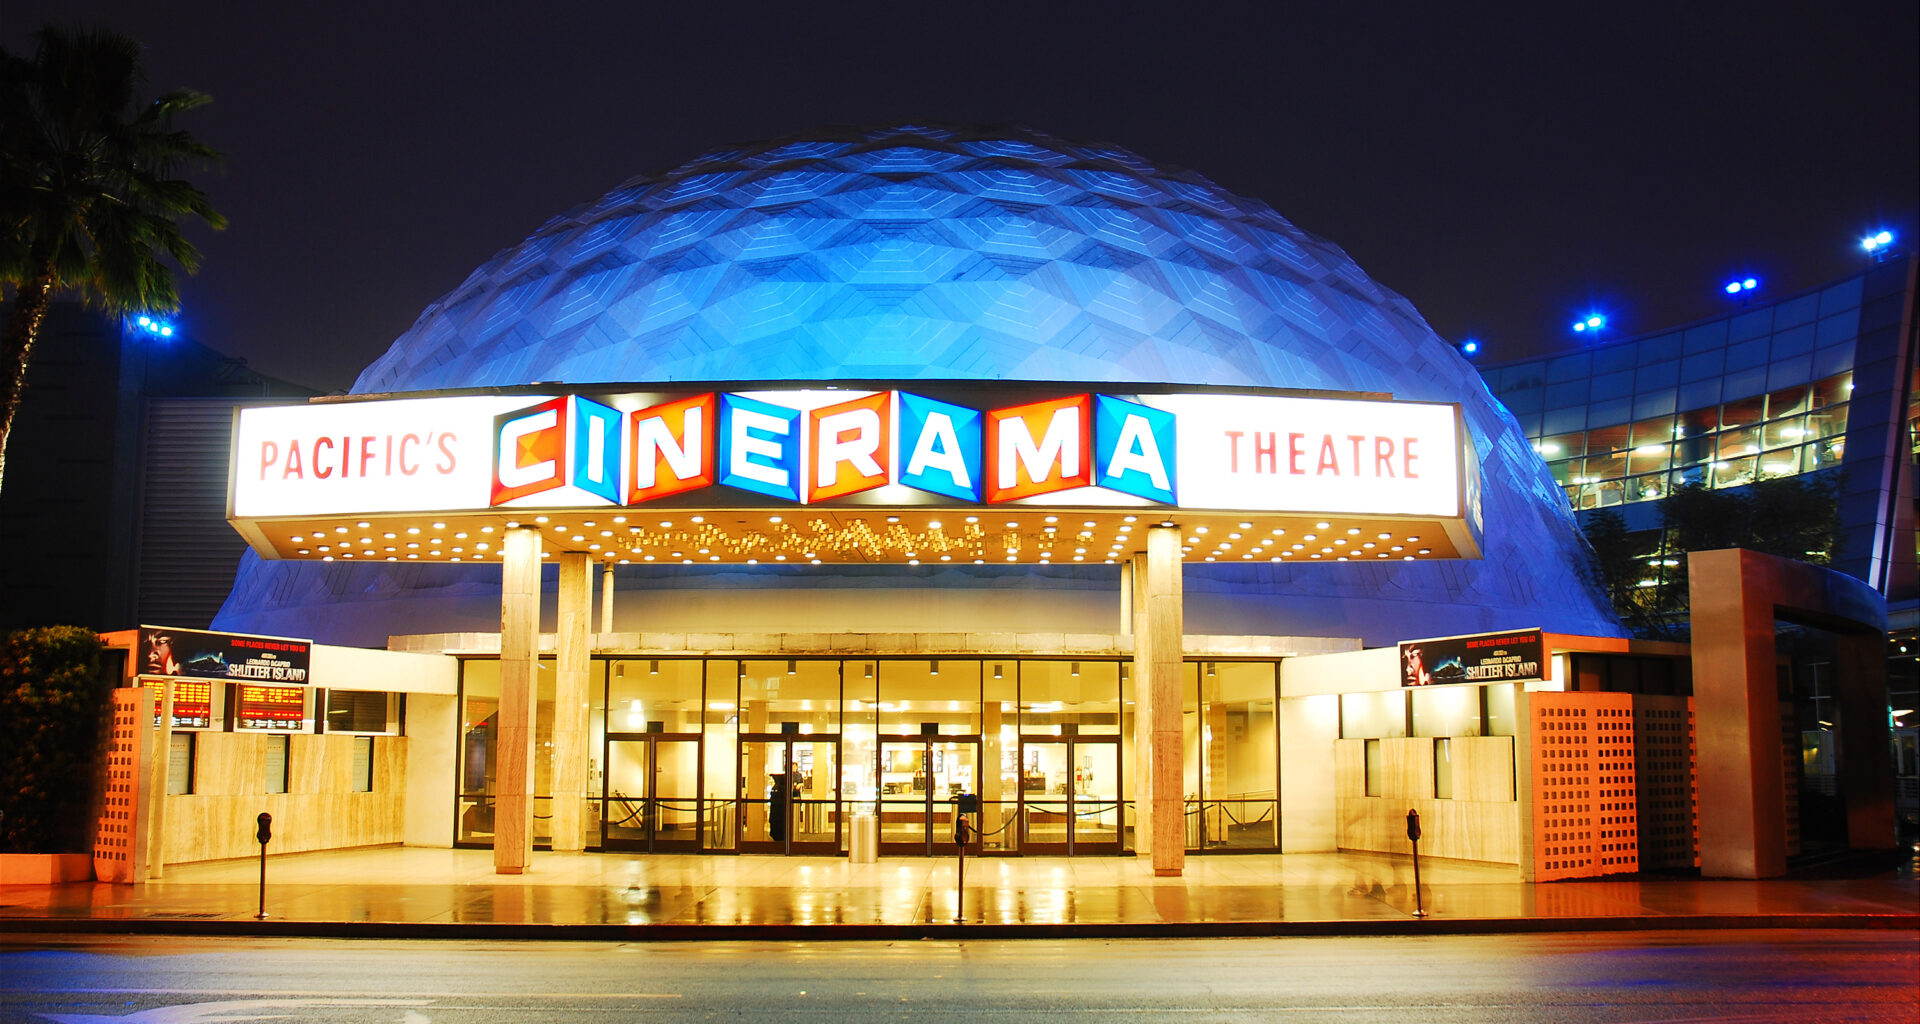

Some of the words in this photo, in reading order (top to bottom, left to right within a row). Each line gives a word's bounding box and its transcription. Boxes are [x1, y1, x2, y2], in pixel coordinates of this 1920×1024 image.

[260, 430, 458, 481] PACIFIC'S
[499, 405, 1173, 492] CINERAMA
[1224, 430, 1420, 480] THEATRE
[228, 663, 271, 679] SHUTTER
[272, 666, 306, 681] ISLAND
[1466, 664, 1504, 680] SHUTTER
[1504, 661, 1538, 678] ISLAND
